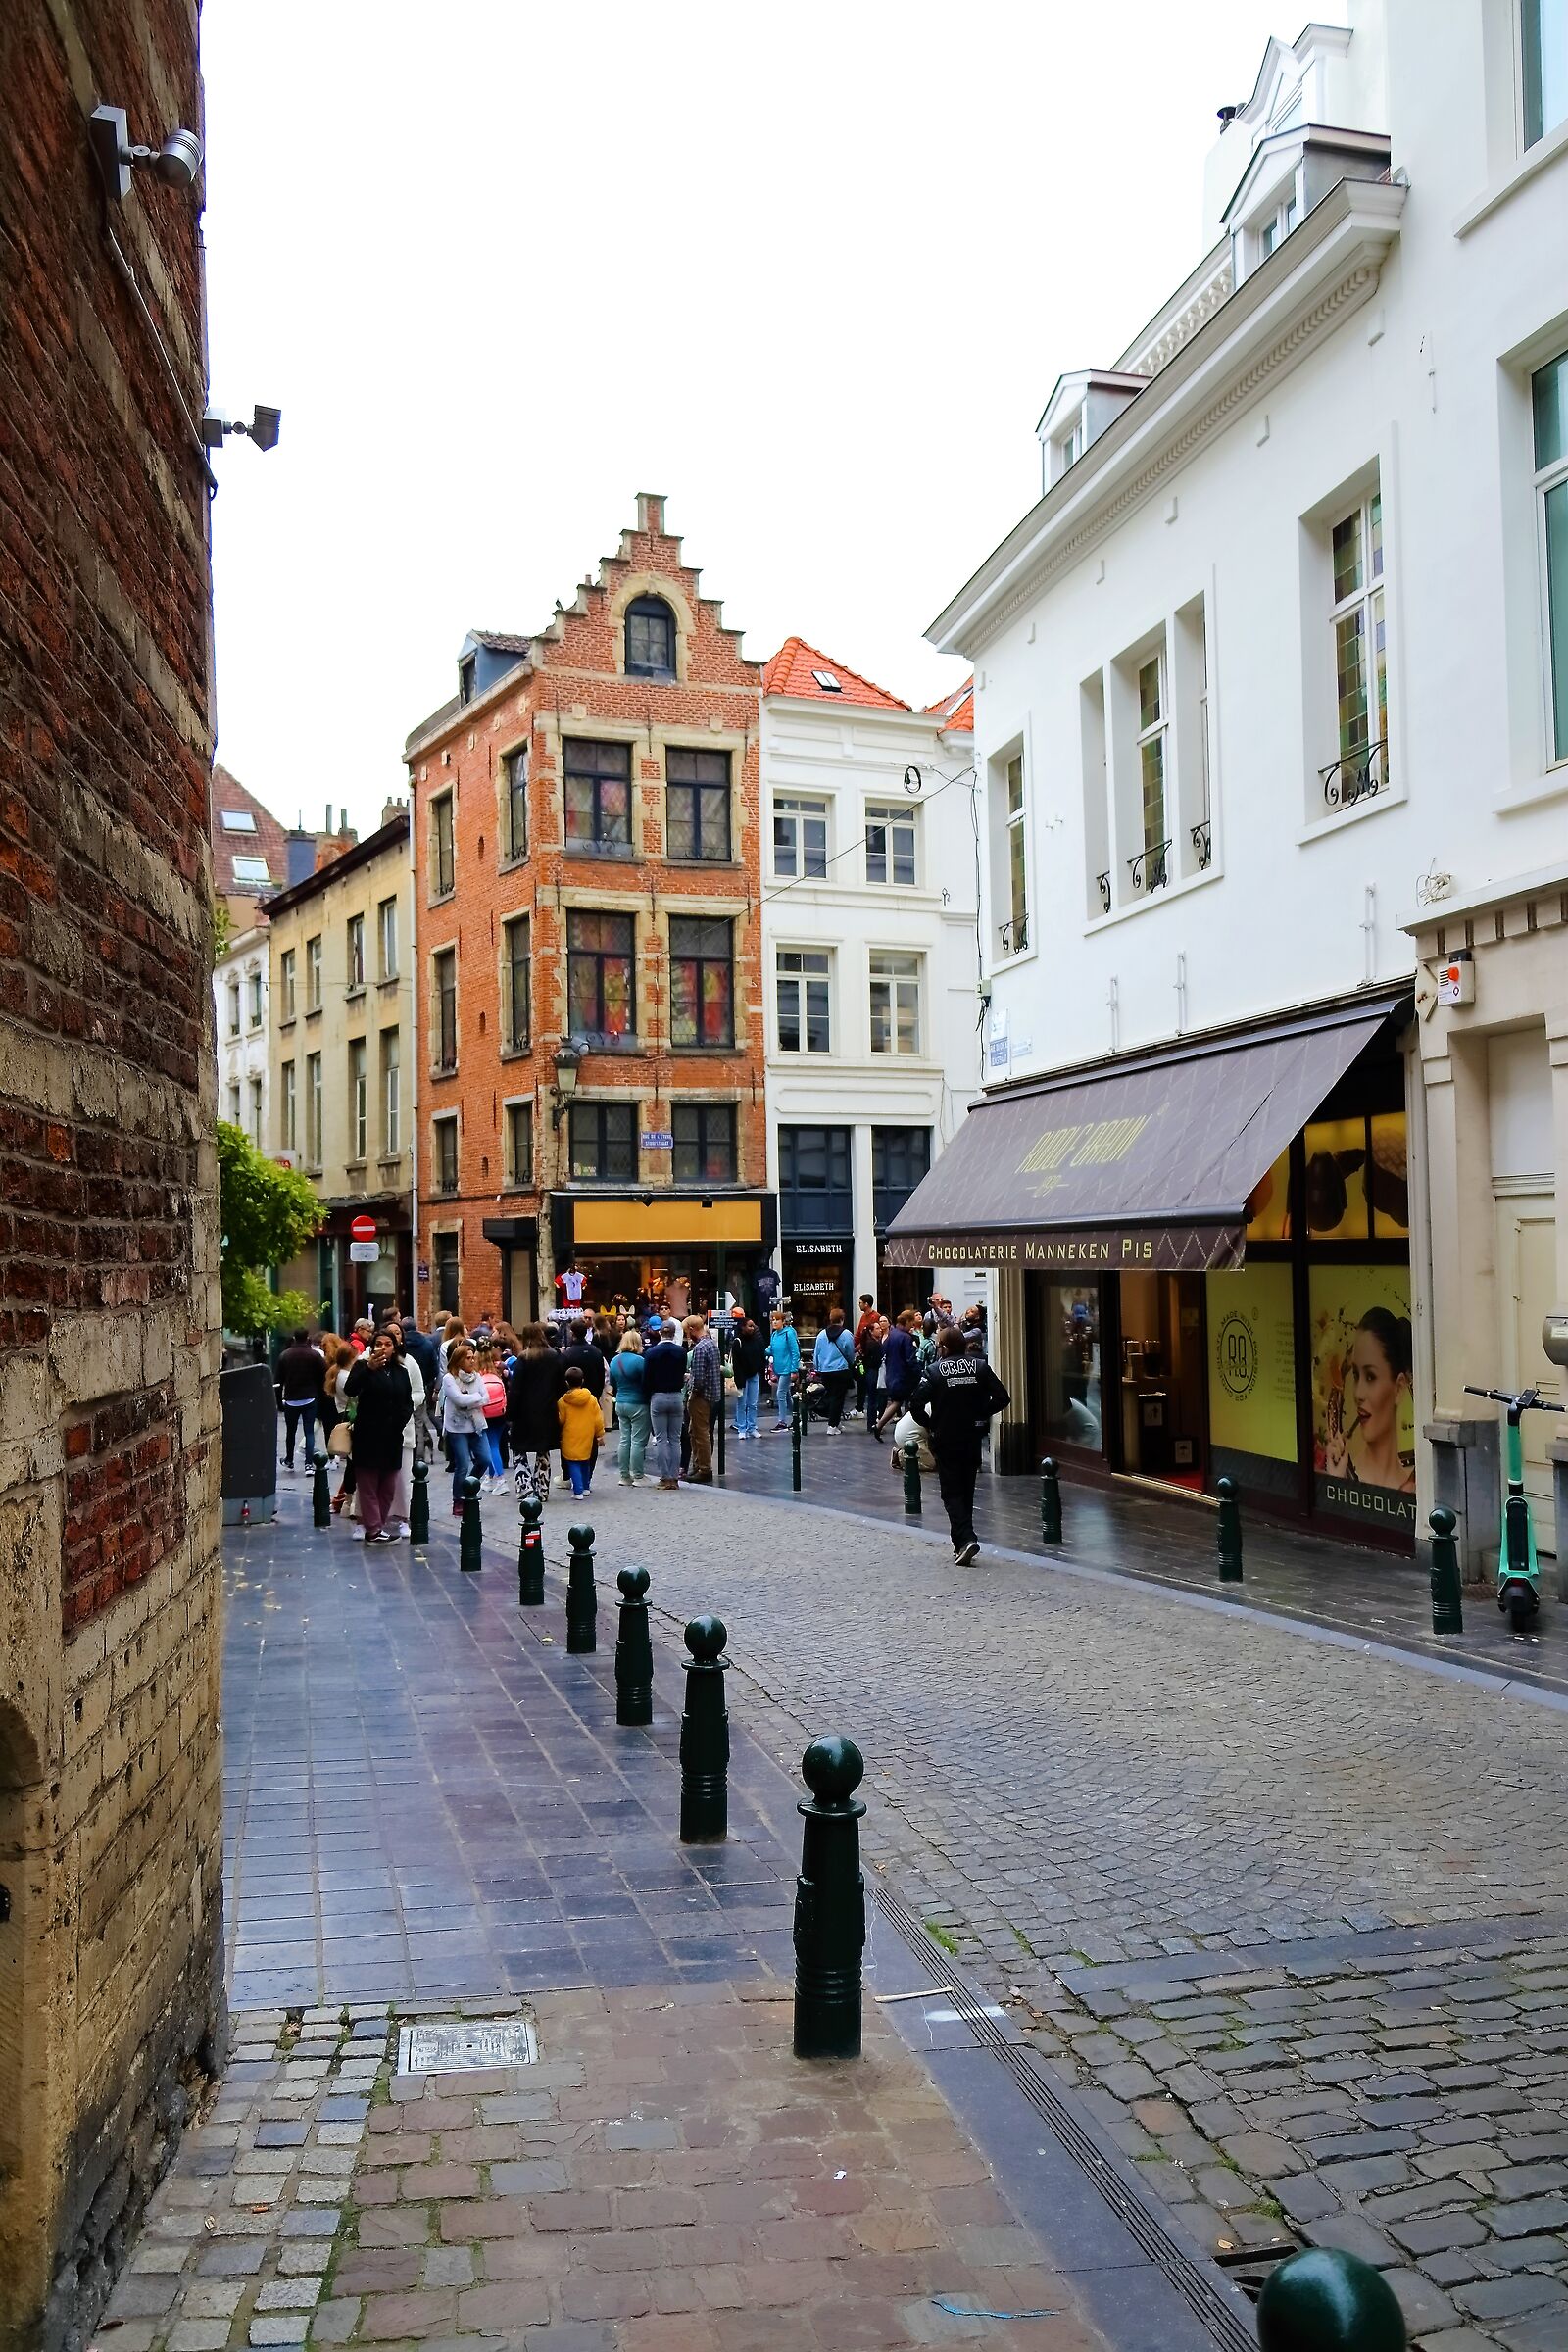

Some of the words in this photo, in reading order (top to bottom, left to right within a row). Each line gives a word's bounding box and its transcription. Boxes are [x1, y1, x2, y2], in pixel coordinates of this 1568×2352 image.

[928, 1244, 1017, 1260] CHOCOLATERIE
[1025, 1242, 1109, 1259] MANNEKEN
[1122, 1239, 1152, 1259] PIS
[939, 1358, 977, 1376] CREW
[1327, 1485, 1417, 1520] CHOCOLAT
